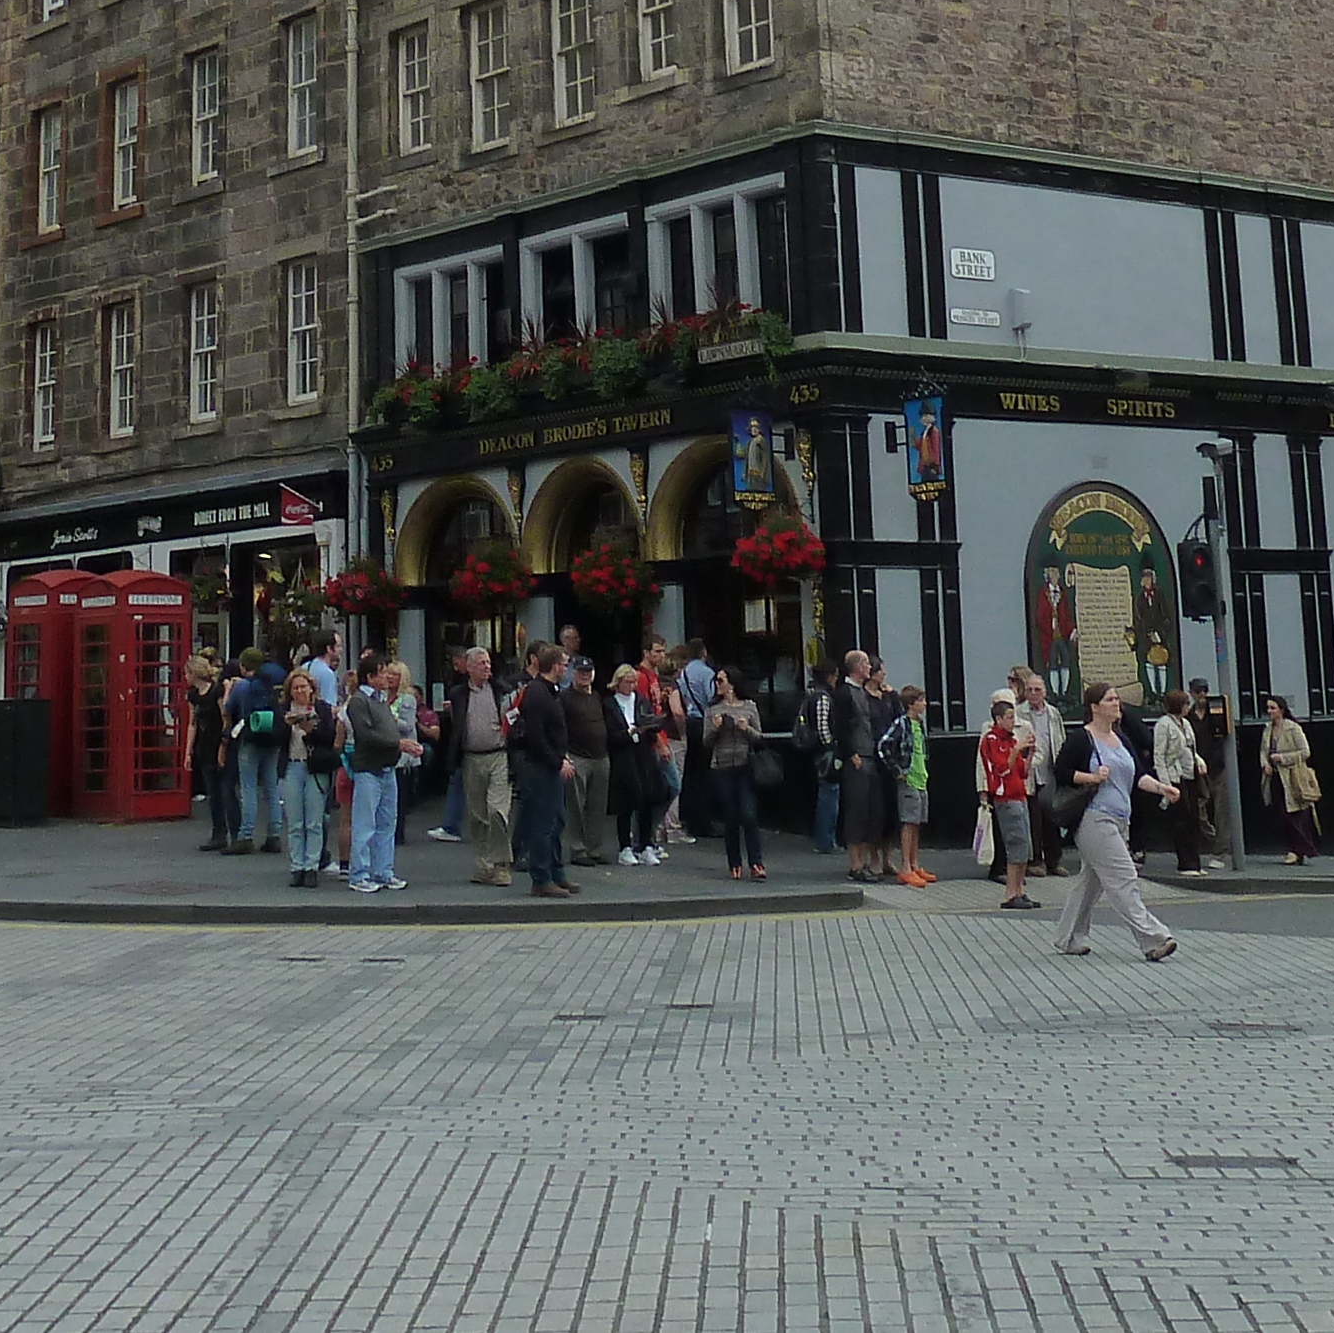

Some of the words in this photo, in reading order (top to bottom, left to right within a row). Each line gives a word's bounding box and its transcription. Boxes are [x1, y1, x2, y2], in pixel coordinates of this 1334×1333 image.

[959, 251, 986, 264] BANK
[955, 264, 992, 278] STREET
[789, 383, 820, 404] 435
[999, 392, 1061, 412] WINES
[1107, 398, 1176, 418] SPIRITS
[479, 430, 534, 455] DEACON
[543, 417, 607, 445] BRODIE'S
[612, 408, 671, 434] TAVERN
[194, 510, 217, 527] DIRECT
[218, 507, 237, 523] FROM
[238, 504, 252, 520] THE
[253, 501, 271, 517] MILL
